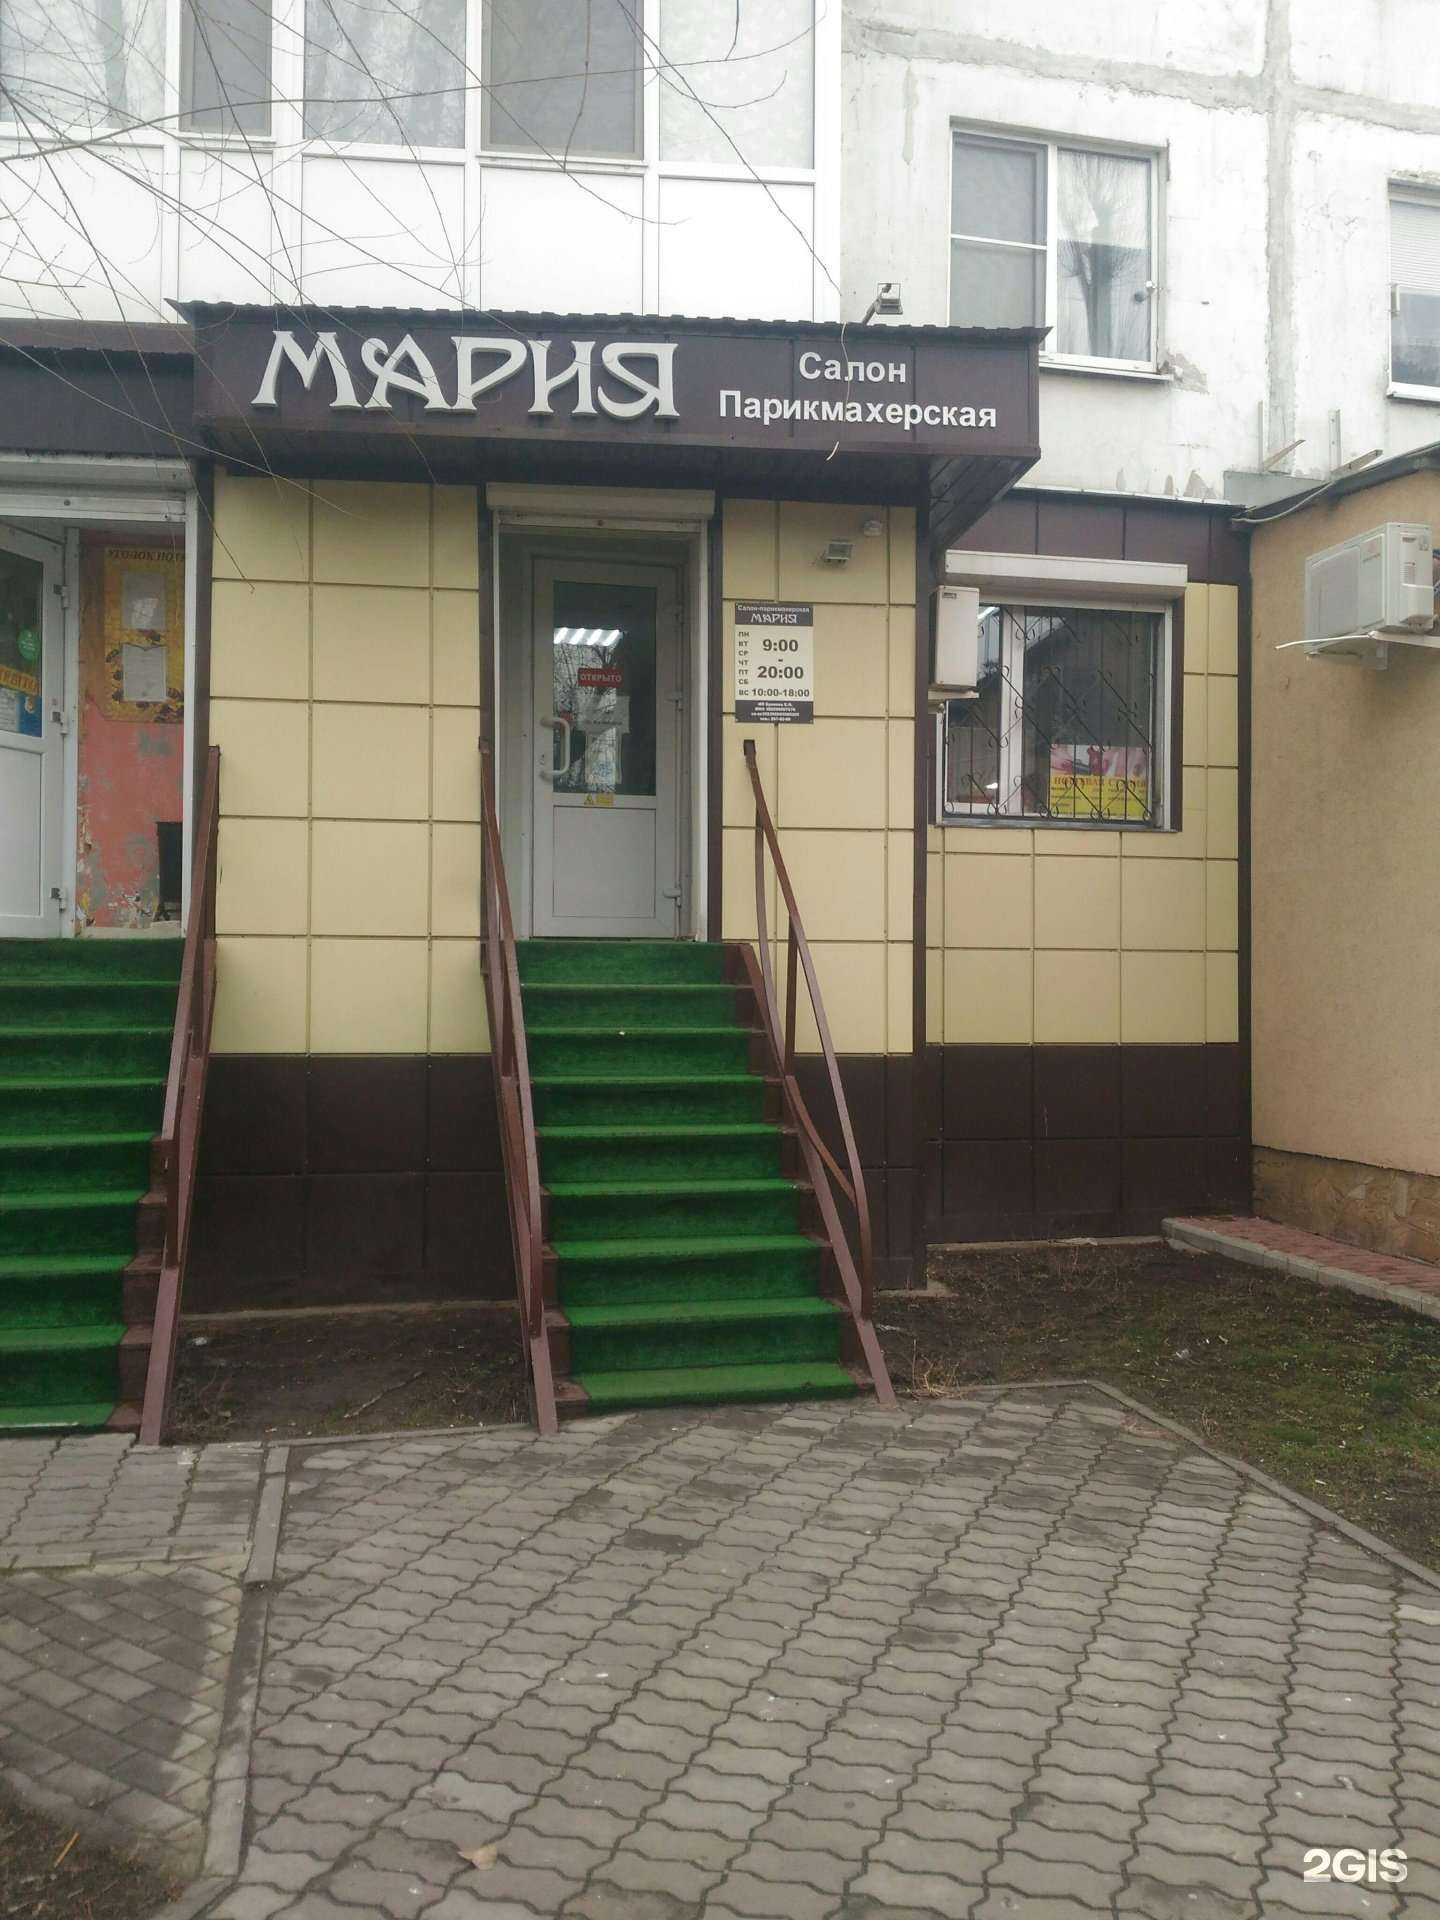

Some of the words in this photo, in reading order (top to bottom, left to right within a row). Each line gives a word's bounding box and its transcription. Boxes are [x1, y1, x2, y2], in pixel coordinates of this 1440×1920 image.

[799, 351, 906, 383] Салон
[250, 330, 681, 420] МАРИЯ
[719, 389, 997, 430] Парикмахерская
[750, 613, 798, 624] МАРИЯ
[762, 638, 799, 652] 9:00
[579, 673, 622, 682] ОТКРЫТО
[757, 665, 804, 679] 20:00
[752, 688, 810, 697] 10:00-18:00
